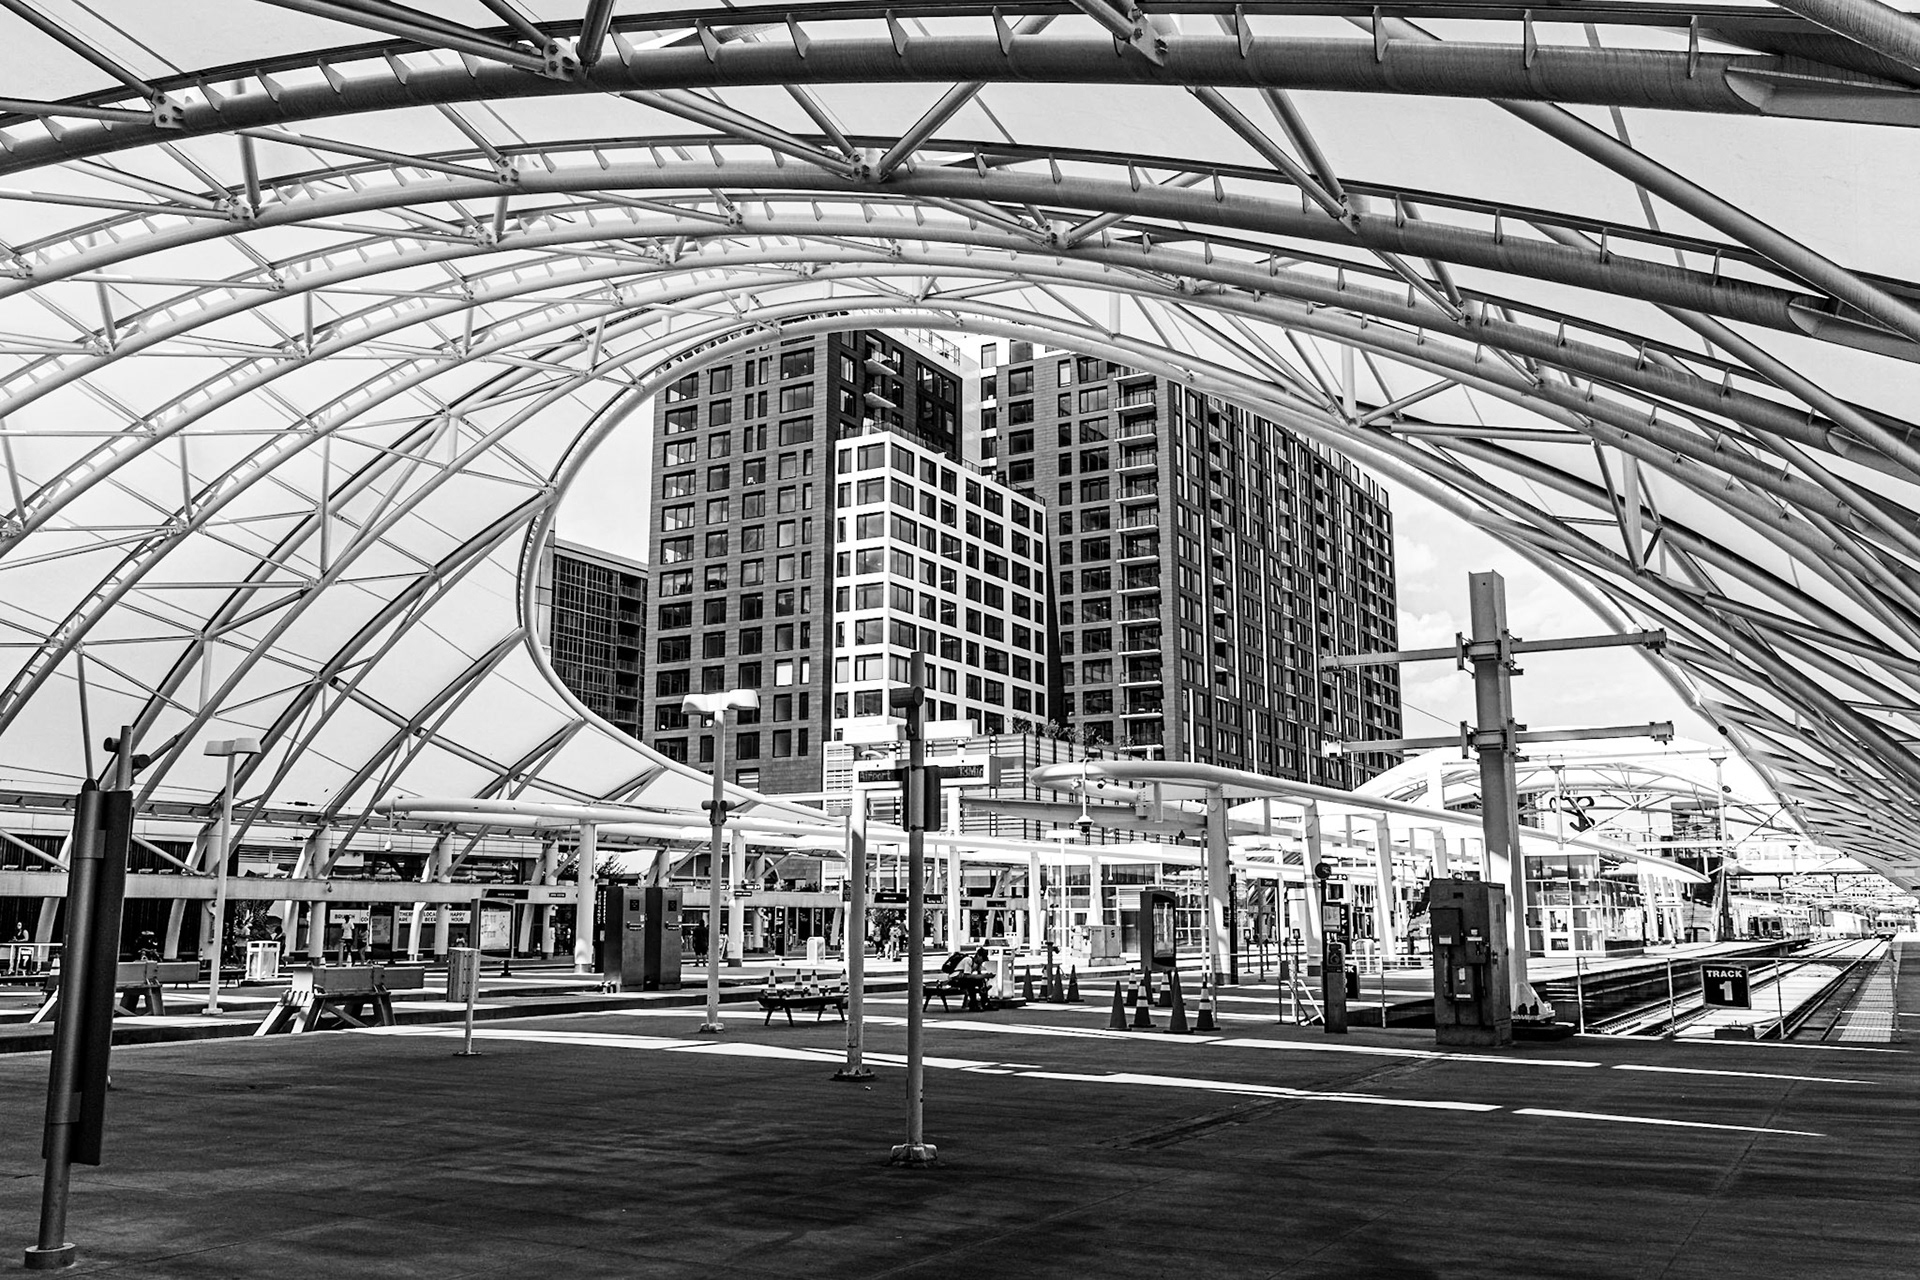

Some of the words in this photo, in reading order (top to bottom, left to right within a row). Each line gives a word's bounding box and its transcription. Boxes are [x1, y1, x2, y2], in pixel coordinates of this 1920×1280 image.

[860, 769, 891, 781] Airport
[22, 955, 30, 967] 7
[1706, 970, 1743, 978] TRACK
[1719, 980, 1734, 1001] 1
